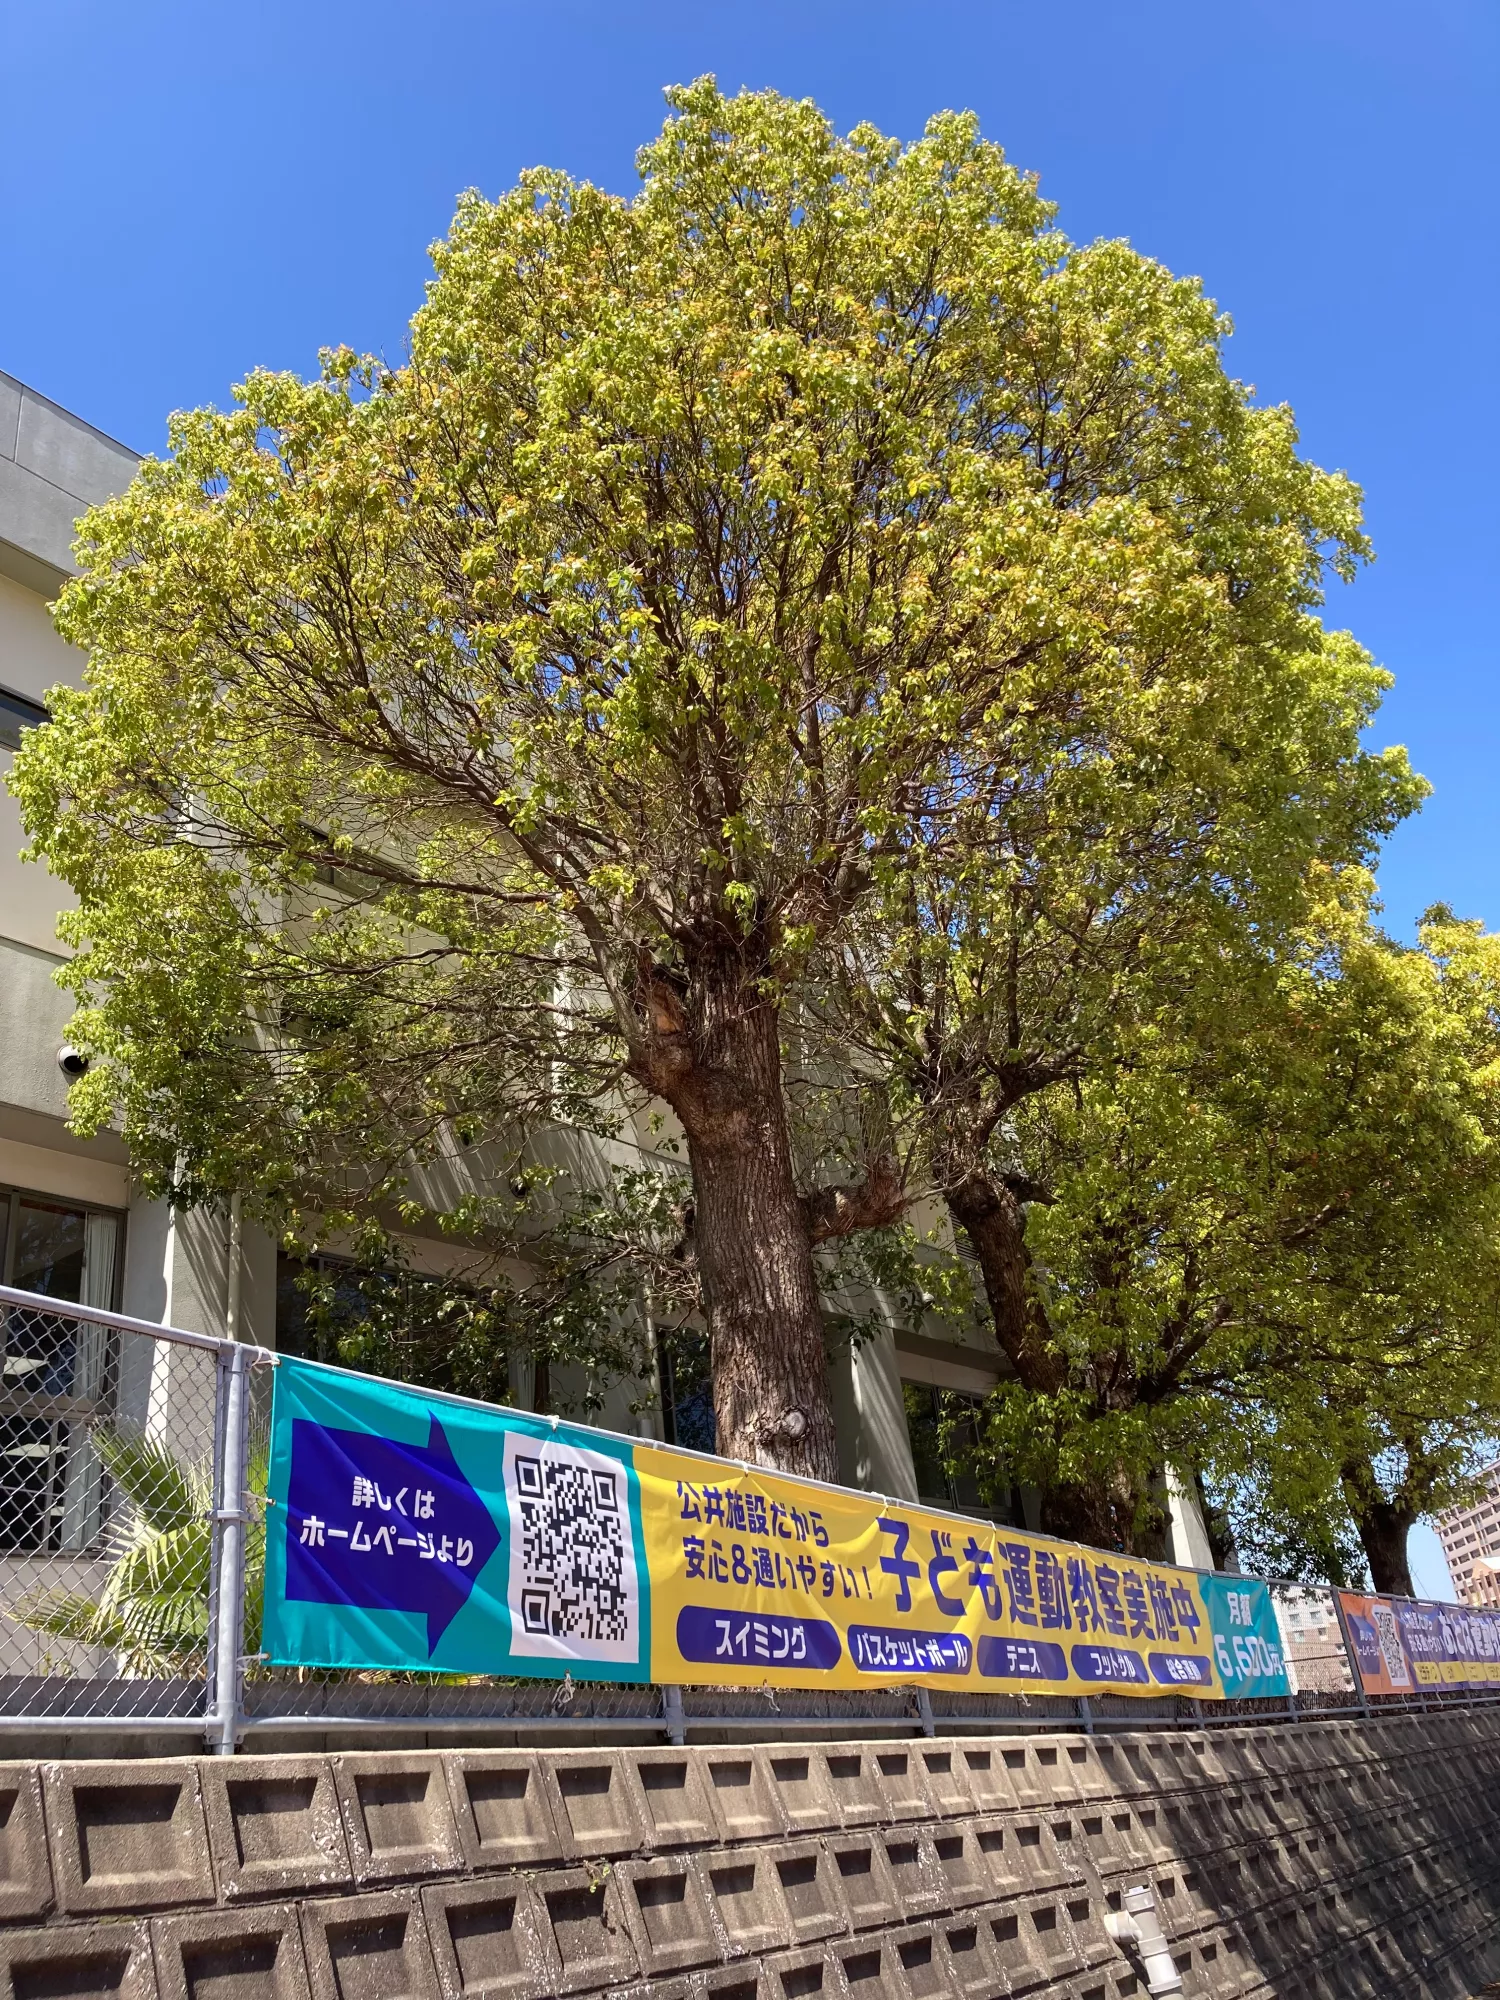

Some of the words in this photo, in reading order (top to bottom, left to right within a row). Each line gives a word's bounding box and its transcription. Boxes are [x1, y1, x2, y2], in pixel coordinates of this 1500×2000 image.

[352, 1475, 435, 1519] 詳しくは
[677, 1481, 830, 1548] 公共施設だから
[299, 1515, 474, 1567] ホームページより
[876, 1517, 1201, 1644] 子ども運動教室実施中
[714, 1619, 808, 1660] スイミング
[856, 1632, 968, 1669] バスケットボール
[1006, 1645, 1041, 1674] テニス
[1093, 1652, 1136, 1678] フットサル
